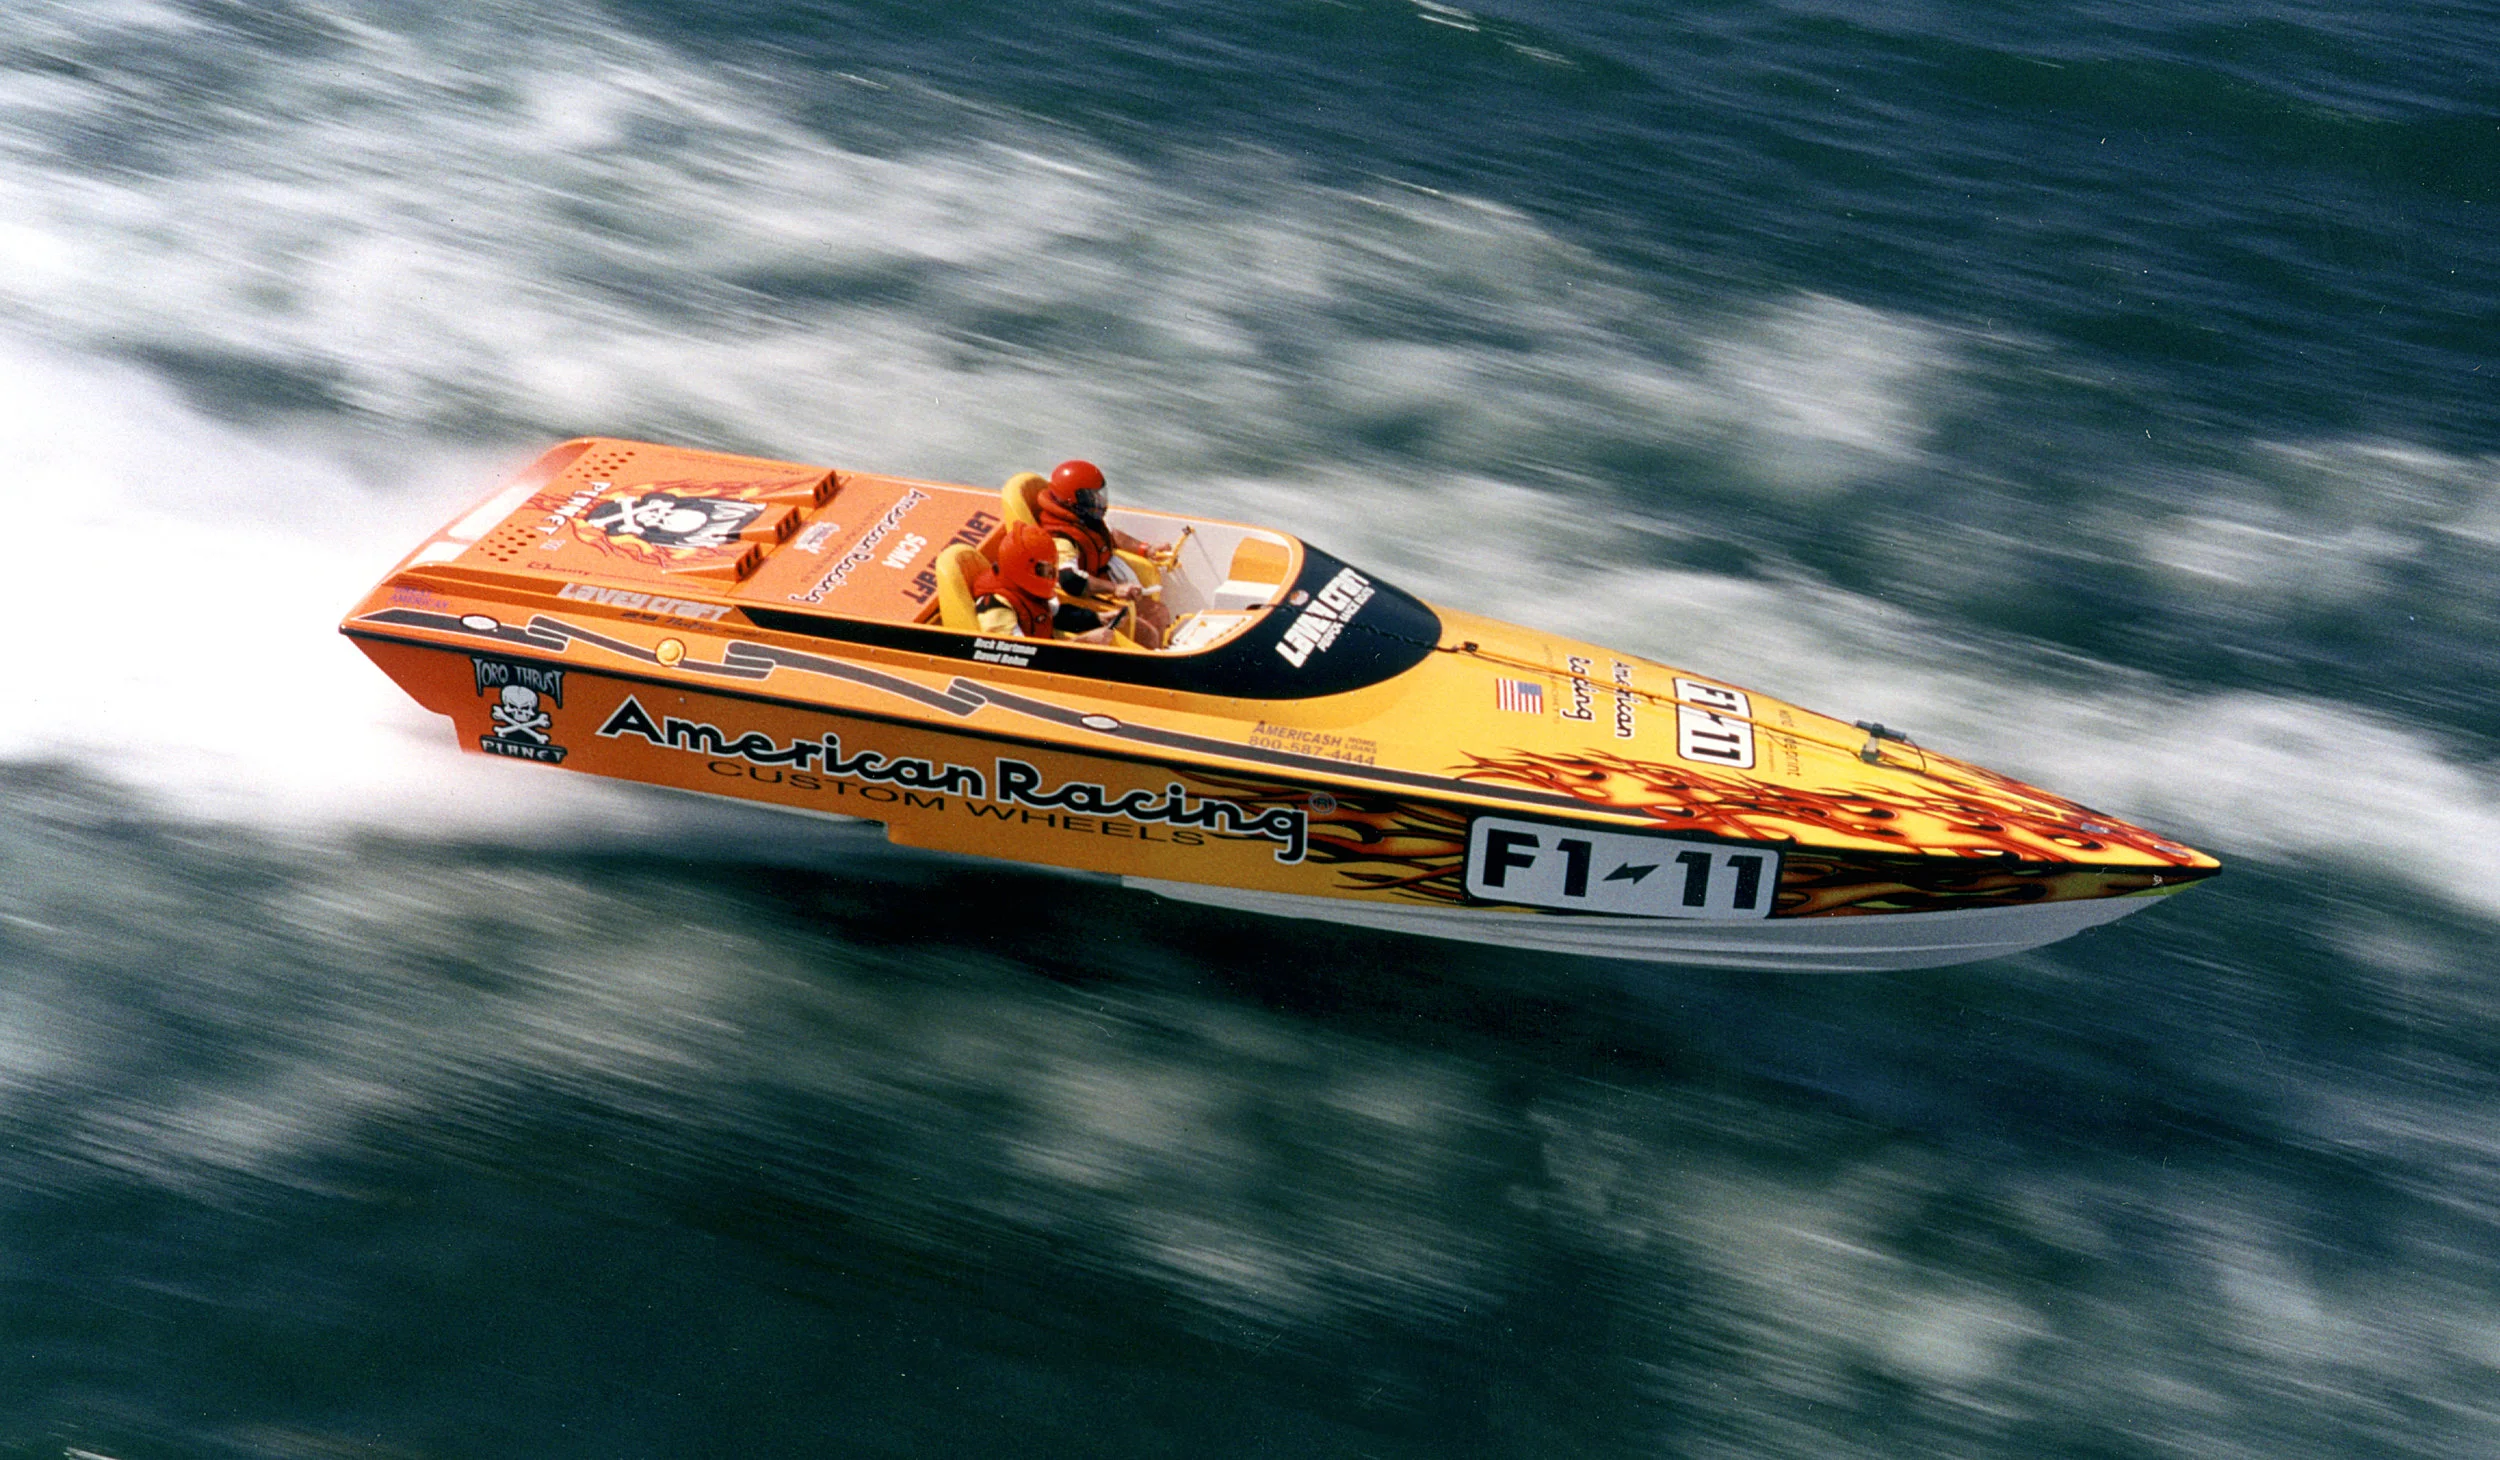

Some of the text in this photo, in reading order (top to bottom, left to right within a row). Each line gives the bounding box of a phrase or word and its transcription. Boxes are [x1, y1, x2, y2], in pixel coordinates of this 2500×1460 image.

[881, 532, 928, 570] SCMA
[513, 664, 563, 708] THRUST
[1252, 719, 1343, 747] AMERICASH
[1686, 682, 1741, 761] F1 11
[480, 739, 563, 762] PLANET
[1249, 735, 1376, 766] 800-587-4444
[595, 694, 986, 799] American
[995, 756, 1308, 865] Racing
[707, 760, 1205, 846] CUSTOM WHEELS
[1483, 828, 1763, 910] F1 11
